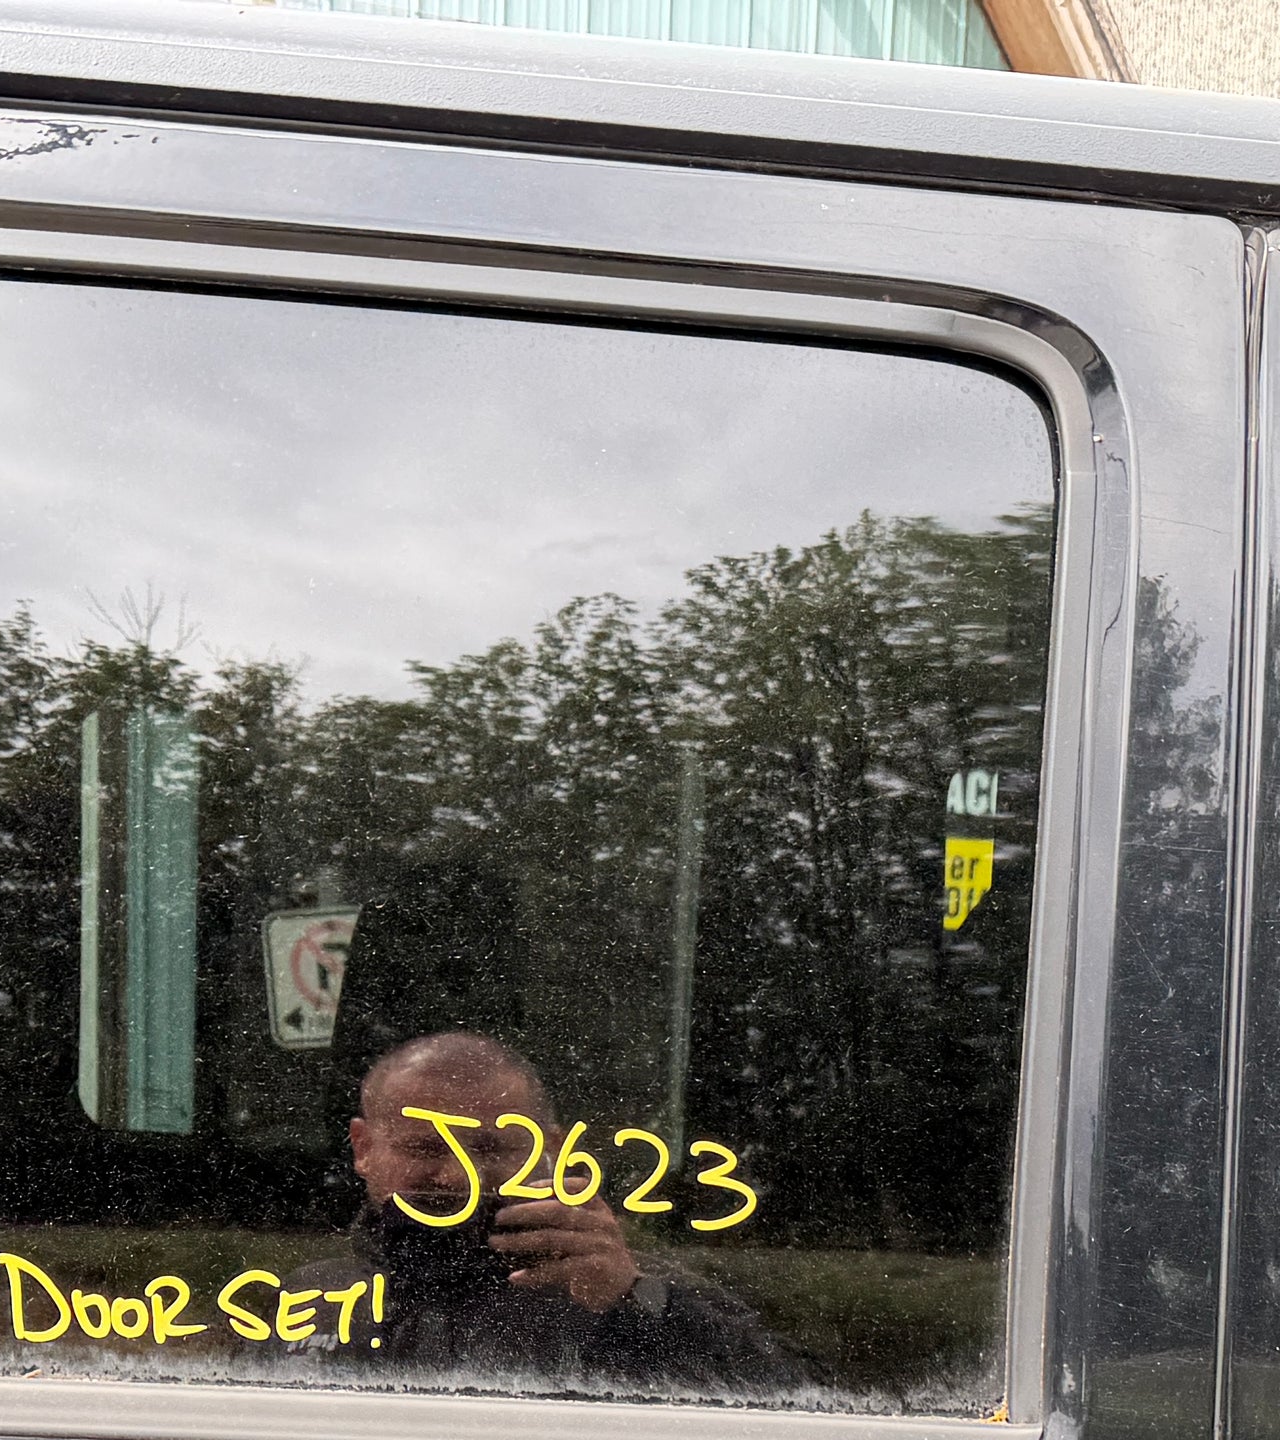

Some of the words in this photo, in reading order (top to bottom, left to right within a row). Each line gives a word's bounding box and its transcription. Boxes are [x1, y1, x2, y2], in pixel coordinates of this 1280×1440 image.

[947, 769, 999, 816] AC
[391, 1106, 758, 1231] J2623
[216, 1268, 388, 1348] SET!
